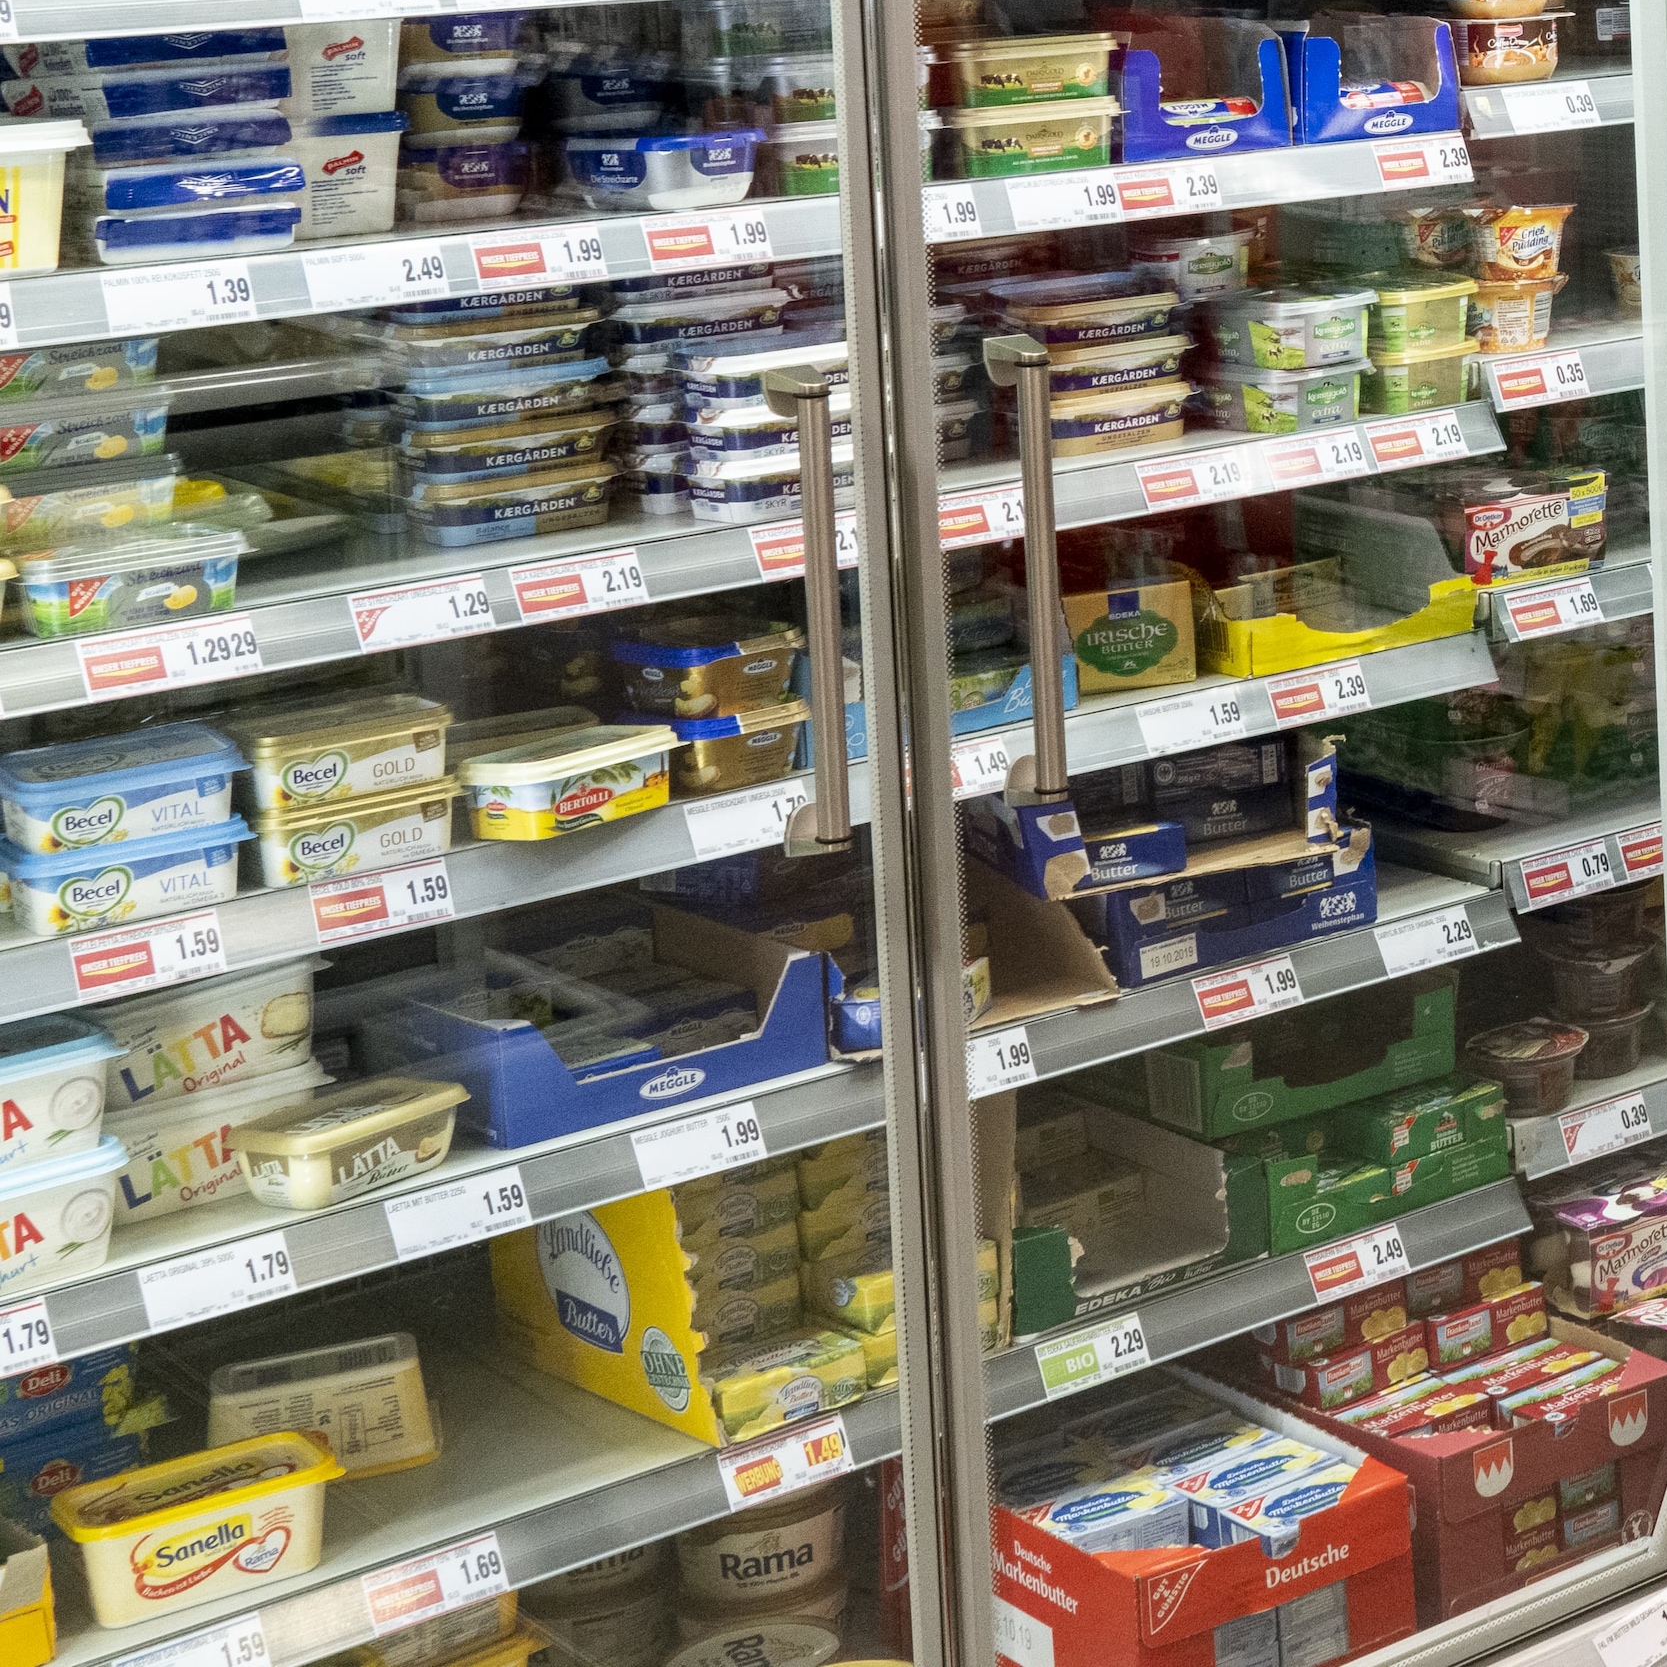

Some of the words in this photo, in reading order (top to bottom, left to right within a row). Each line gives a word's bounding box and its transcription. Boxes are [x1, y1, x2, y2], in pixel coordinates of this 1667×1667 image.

[346, 51, 366, 61] soft
[1192, 133, 1231, 147] MEGGLE
[346, 165, 366, 175] soft
[402, 256, 443, 281] 2.49
[207, 278, 249, 304] 1.39
[1092, 367, 1156, 386] KÆRGÅRDEN
[1094, 414, 1159, 432] KÆRGÅRDEN
[1312, 405, 1344, 418] extra
[486, 447, 567, 467] KÆRGÅRDEN
[494, 499, 574, 519] KÆRGÅRDEN
[1475, 501, 1564, 554] Marmorette
[602, 567, 641, 593] 2.19
[449, 591, 489, 618] 1.29
[1570, 593, 1598, 615] 1.69
[1087, 621, 1169, 646] IRISCHE
[1102, 639, 1153, 653] BUTTER
[1335, 674, 1365, 700] 2.39
[293, 763, 336, 785] Becel
[373, 757, 415, 778] GOLD
[152, 801, 205, 822] VITAL
[560, 790, 610, 814] BERTOLLI
[65, 809, 113, 830] Becel
[301, 835, 344, 856] Becel
[380, 828, 422, 848] GOLD
[1091, 862, 1138, 881] Butter
[1289, 868, 1328, 887] Butter
[73, 879, 120, 901] Becel
[160, 873, 213, 894] VITAL
[1311, 911, 1364, 931] Weihenstephan
[1443, 920, 1472, 944] 2.29
[1150, 946, 1194, 969] 19.10.2019
[1265, 969, 1296, 994] 1.99
[120, 1013, 251, 1102] LÄTTA
[183, 1050, 247, 1093] Original
[648, 1073, 697, 1094] MEGGLE
[1621, 1105, 1648, 1129] 0.39
[722, 1119, 760, 1148] 1.99
[1430, 1132, 1464, 1151] BUTTER
[339, 1137, 401, 1185] LÄTTA
[180, 1162, 243, 1201] Original
[483, 1184, 524, 1217] 1.59
[246, 1250, 289, 1284] 1.79
[1075, 1285, 1142, 1316] EDEKA
[1496, 1295, 1543, 1320] Markenbutter
[563, 1298, 617, 1344] Butter
[1376, 1333, 1423, 1361] Markenbutter
[643, 1352, 684, 1375] OHNE
[1066, 1349, 1095, 1373] BIO
[28, 1369, 62, 1390] Deli
[37, 1470, 71, 1490] Deli
[735, 1460, 783, 1488] WERBUNG
[156, 1523, 244, 1568] Sanella
[245, 1547, 278, 1567] Rama
[1014, 1540, 1052, 1574] Deutsche
[719, 1541, 813, 1582] Rama
[1265, 1544, 1350, 1590] Deutsche
